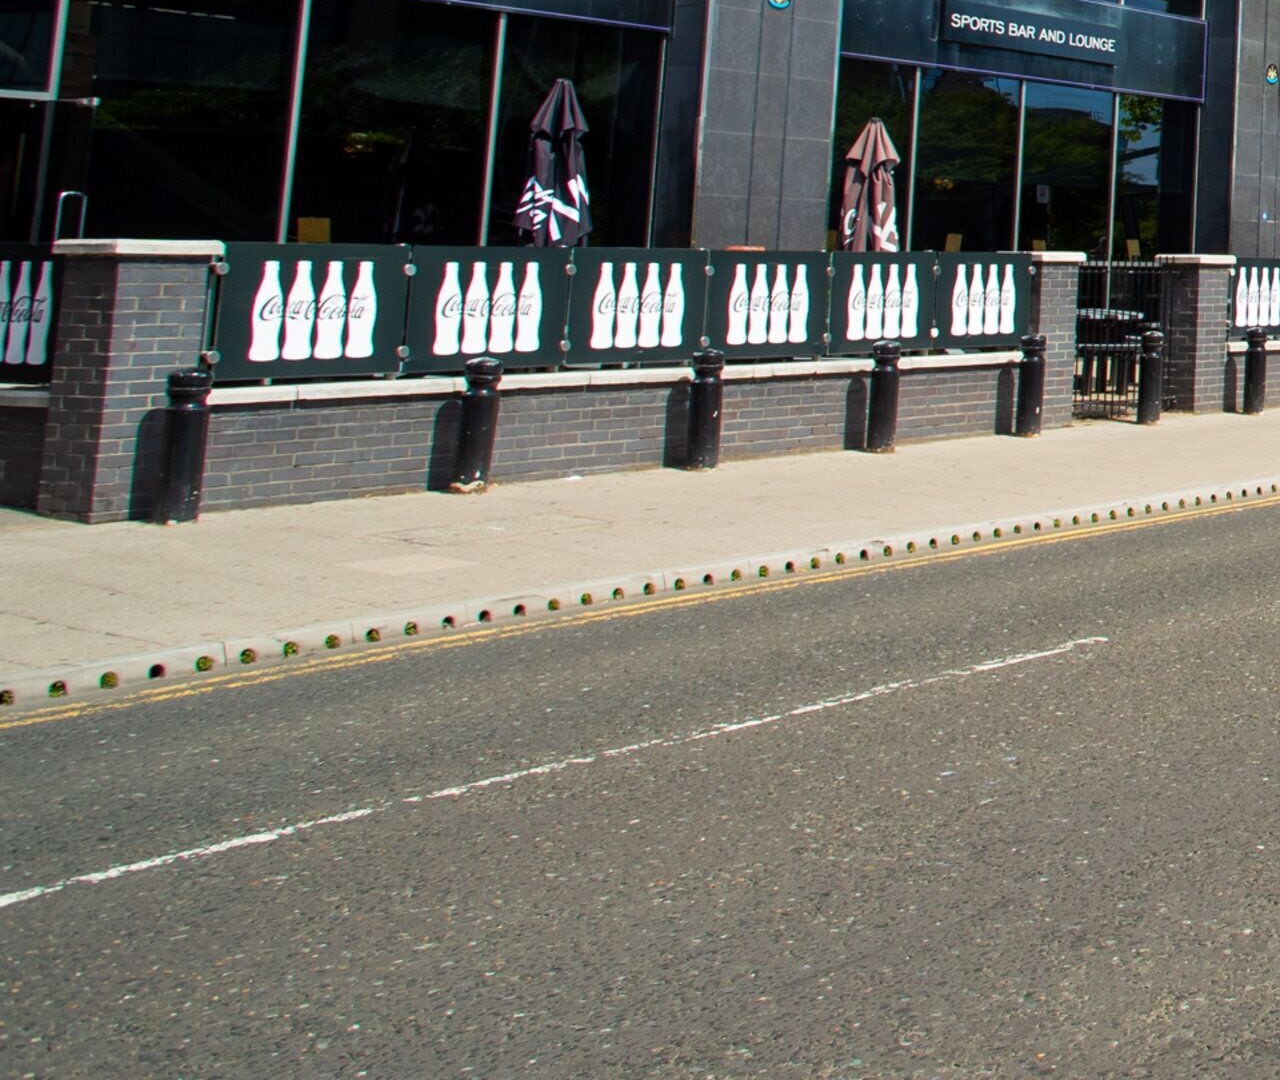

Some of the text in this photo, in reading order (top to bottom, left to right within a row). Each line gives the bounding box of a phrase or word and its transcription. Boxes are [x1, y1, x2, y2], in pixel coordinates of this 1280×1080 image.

[950, 13, 1116, 53] SPORTS BAR AND LOUNGE
